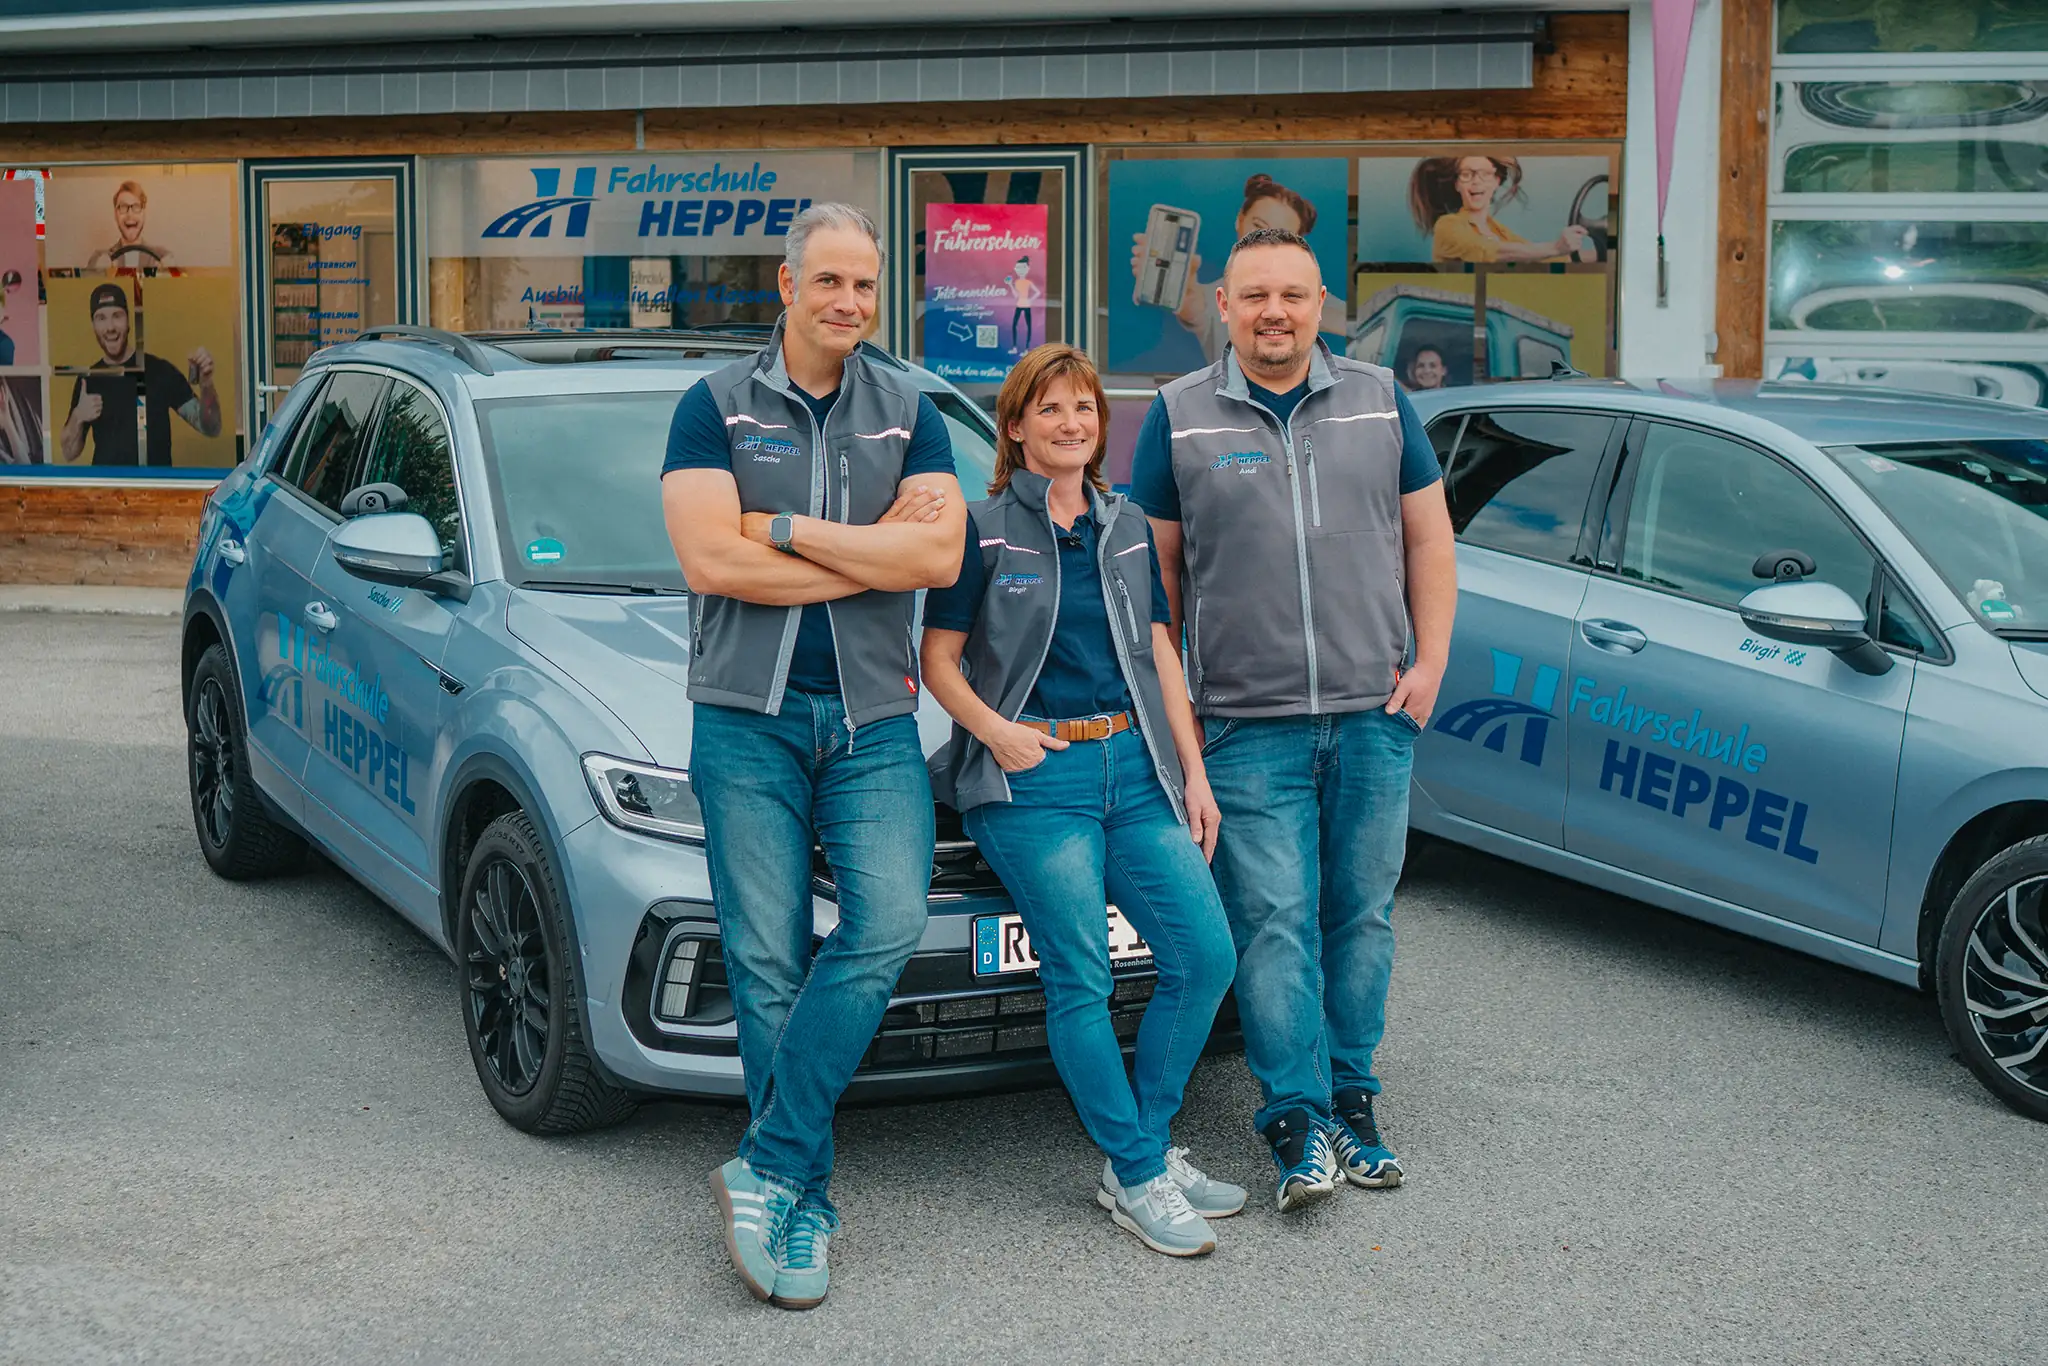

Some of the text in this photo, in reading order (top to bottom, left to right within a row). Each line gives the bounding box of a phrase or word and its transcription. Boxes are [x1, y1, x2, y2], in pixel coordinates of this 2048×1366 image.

[607, 162, 777, 194] Fahrschule
[637, 199, 812, 237] HEPPE
[301, 222, 362, 241] Eingang
[631, 285, 649, 304] in
[653, 284, 698, 305] allen
[704, 285, 781, 304] Klassen
[753, 453, 781, 464] Sascha
[765, 444, 800, 455] HEPPEL
[1238, 466, 1257, 475] Andi
[1008, 586, 1027, 595] Birgit
[1739, 638, 1780, 661] Birgit
[307, 635, 390, 725] Fahrschule
[1568, 676, 1767, 774] Fahrschule
[325, 698, 416, 817] HEPPEL
[1600, 738, 1819, 865] HEPPEL
[983, 951, 993, 965] D
[1114, 957, 1153, 969] Rosenheim
